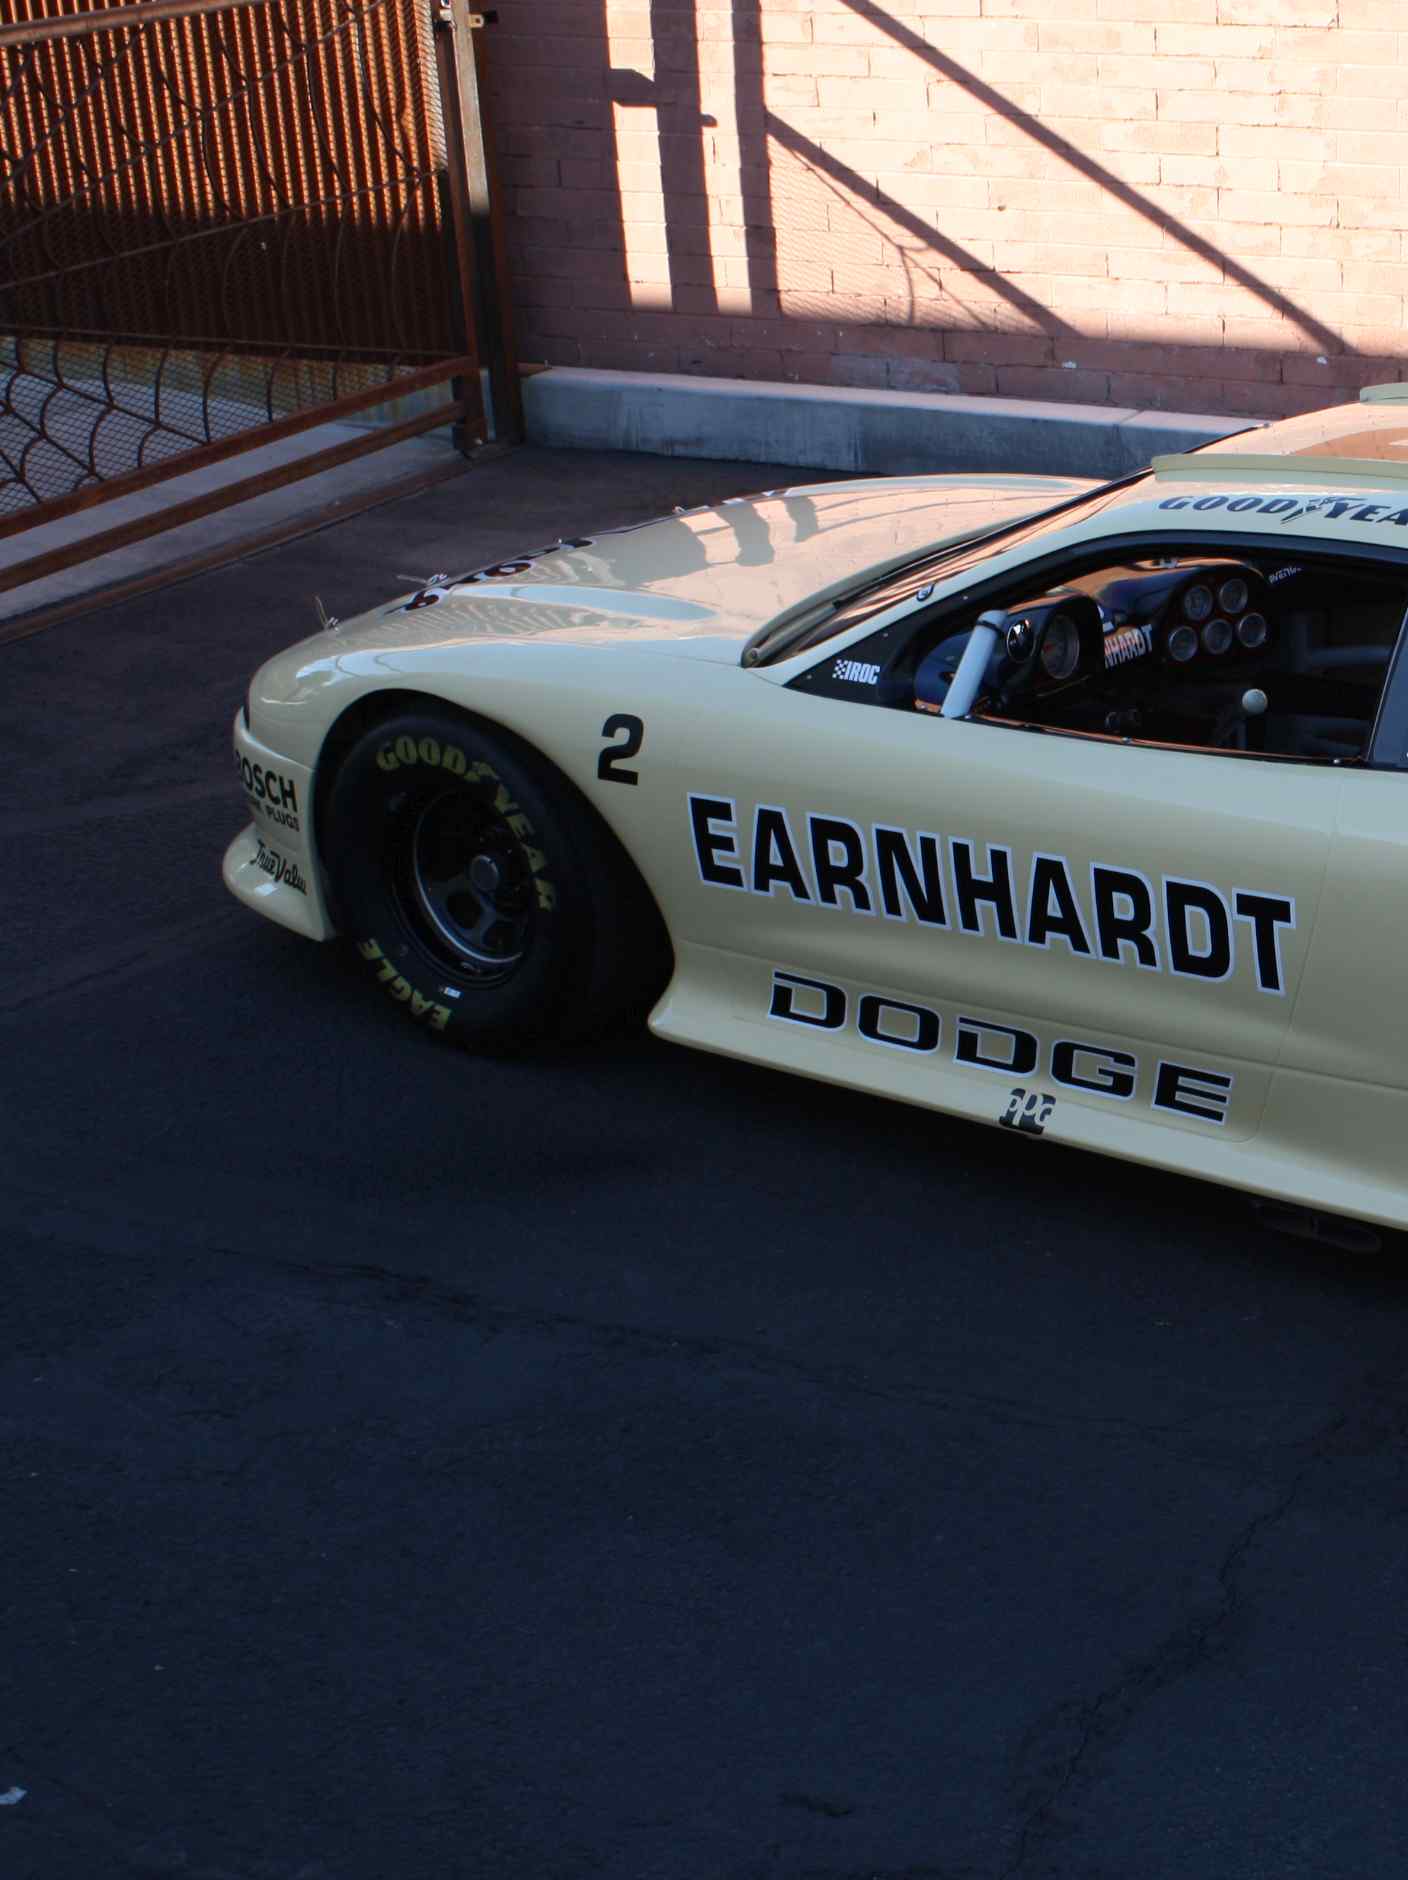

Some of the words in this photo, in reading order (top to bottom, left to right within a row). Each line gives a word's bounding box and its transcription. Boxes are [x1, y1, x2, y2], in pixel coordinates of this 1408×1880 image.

[846, 661, 881, 685] IROC
[597, 713, 644, 786] 2
[687, 791, 1295, 997] EARNHARDT
[357, 937, 453, 1031] EAGLE
[767, 968, 1235, 1126] DODGE
